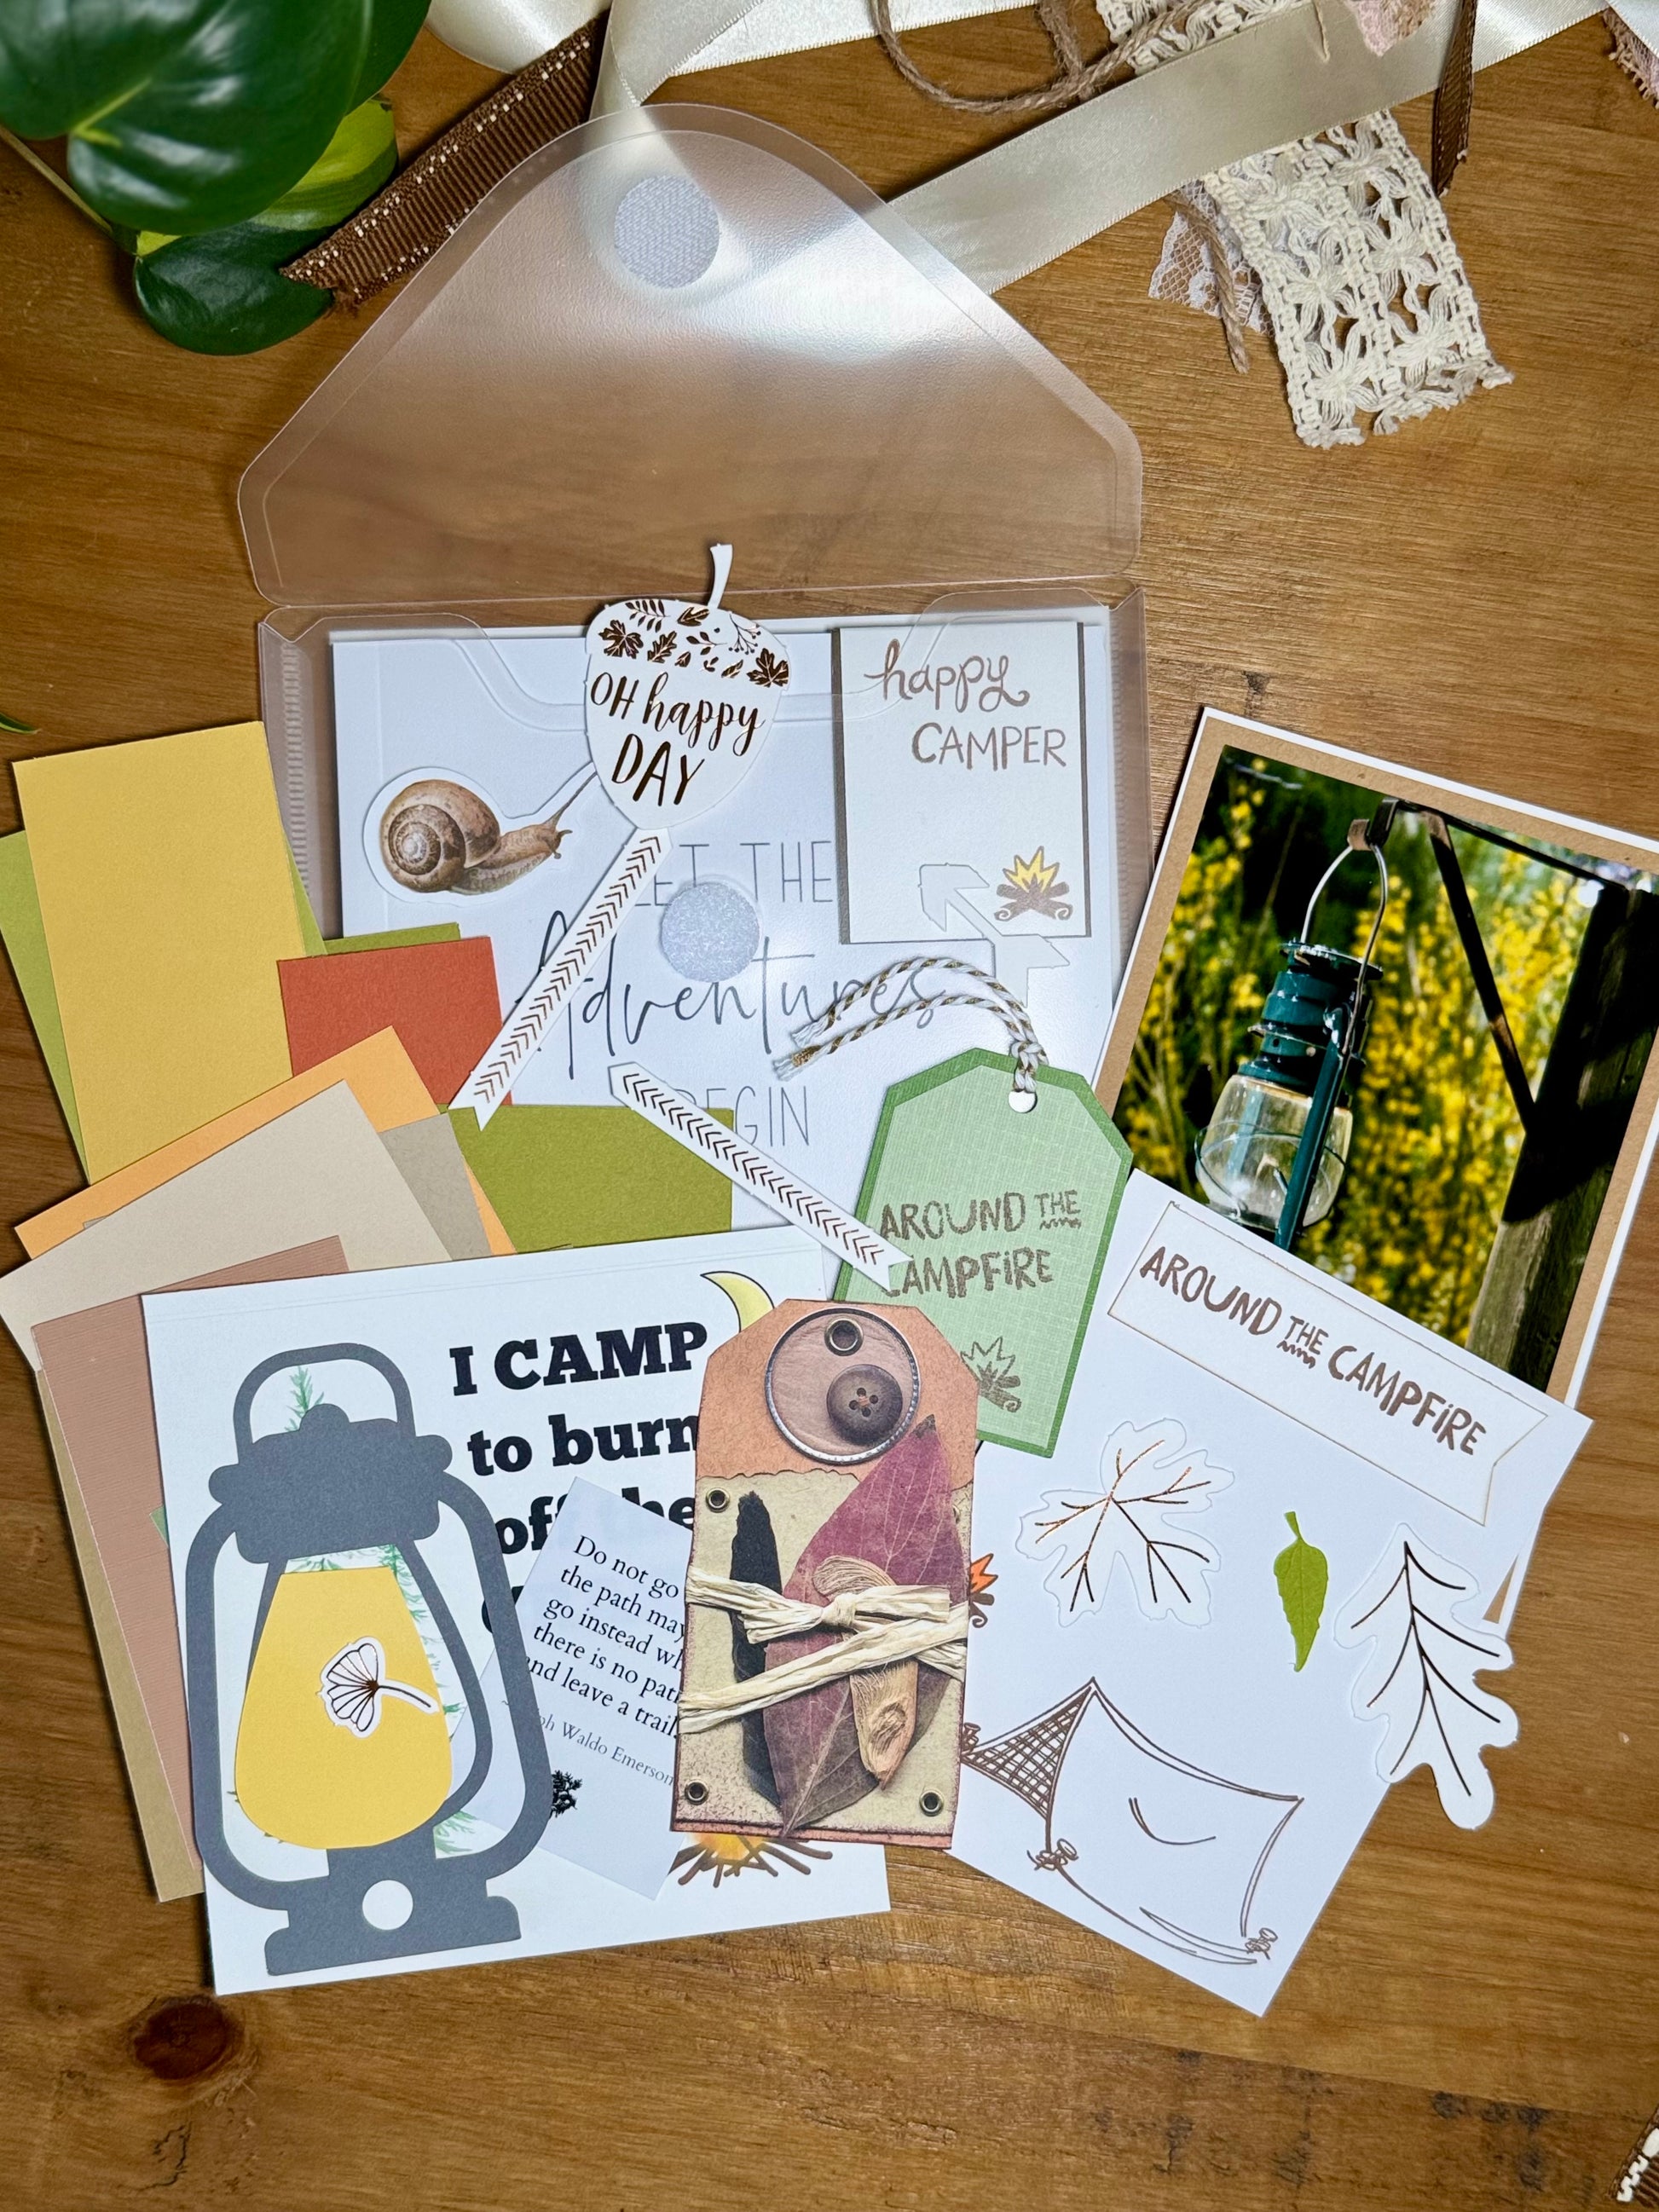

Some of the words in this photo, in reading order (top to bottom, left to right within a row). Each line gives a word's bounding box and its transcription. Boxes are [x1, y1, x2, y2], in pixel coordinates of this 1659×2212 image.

[864, 638, 1030, 713] happy
[590, 672, 639, 719] OH
[643, 672, 766, 756] happy
[611, 733, 705, 806] DAY
[911, 722, 1066, 771] CAMPER
[633, 842, 710, 907] ET
[740, 840, 833, 903] THE
[880, 1192, 1026, 1240] AROUND
[1034, 1189, 1081, 1218] THE
[1140, 1246, 1283, 1336] AROUND
[1284, 1315, 1329, 1354] THE
[449, 1346, 477, 1396] I
[494, 1322, 708, 1390] CAMP
[467, 1430, 533, 1476] to
[548, 1413, 699, 1467] burn
[560, 1565, 593, 1592] the
[593, 1586, 642, 1616] path
[573, 1535, 607, 1565] Do
[611, 1558, 649, 1584] not
[648, 1578, 679, 1599] go
[533, 1622, 586, 1659] there
[589, 1647, 607, 1669] is
[610, 1662, 639, 1684] no
[543, 1598, 574, 1620] go
[578, 1607, 654, 1655] instead
[560, 1666, 613, 1707] leave
[617, 1700, 629, 1716] a
[562, 1721, 608, 1756] Waldo
[610, 1746, 674, 1787] Emerson
